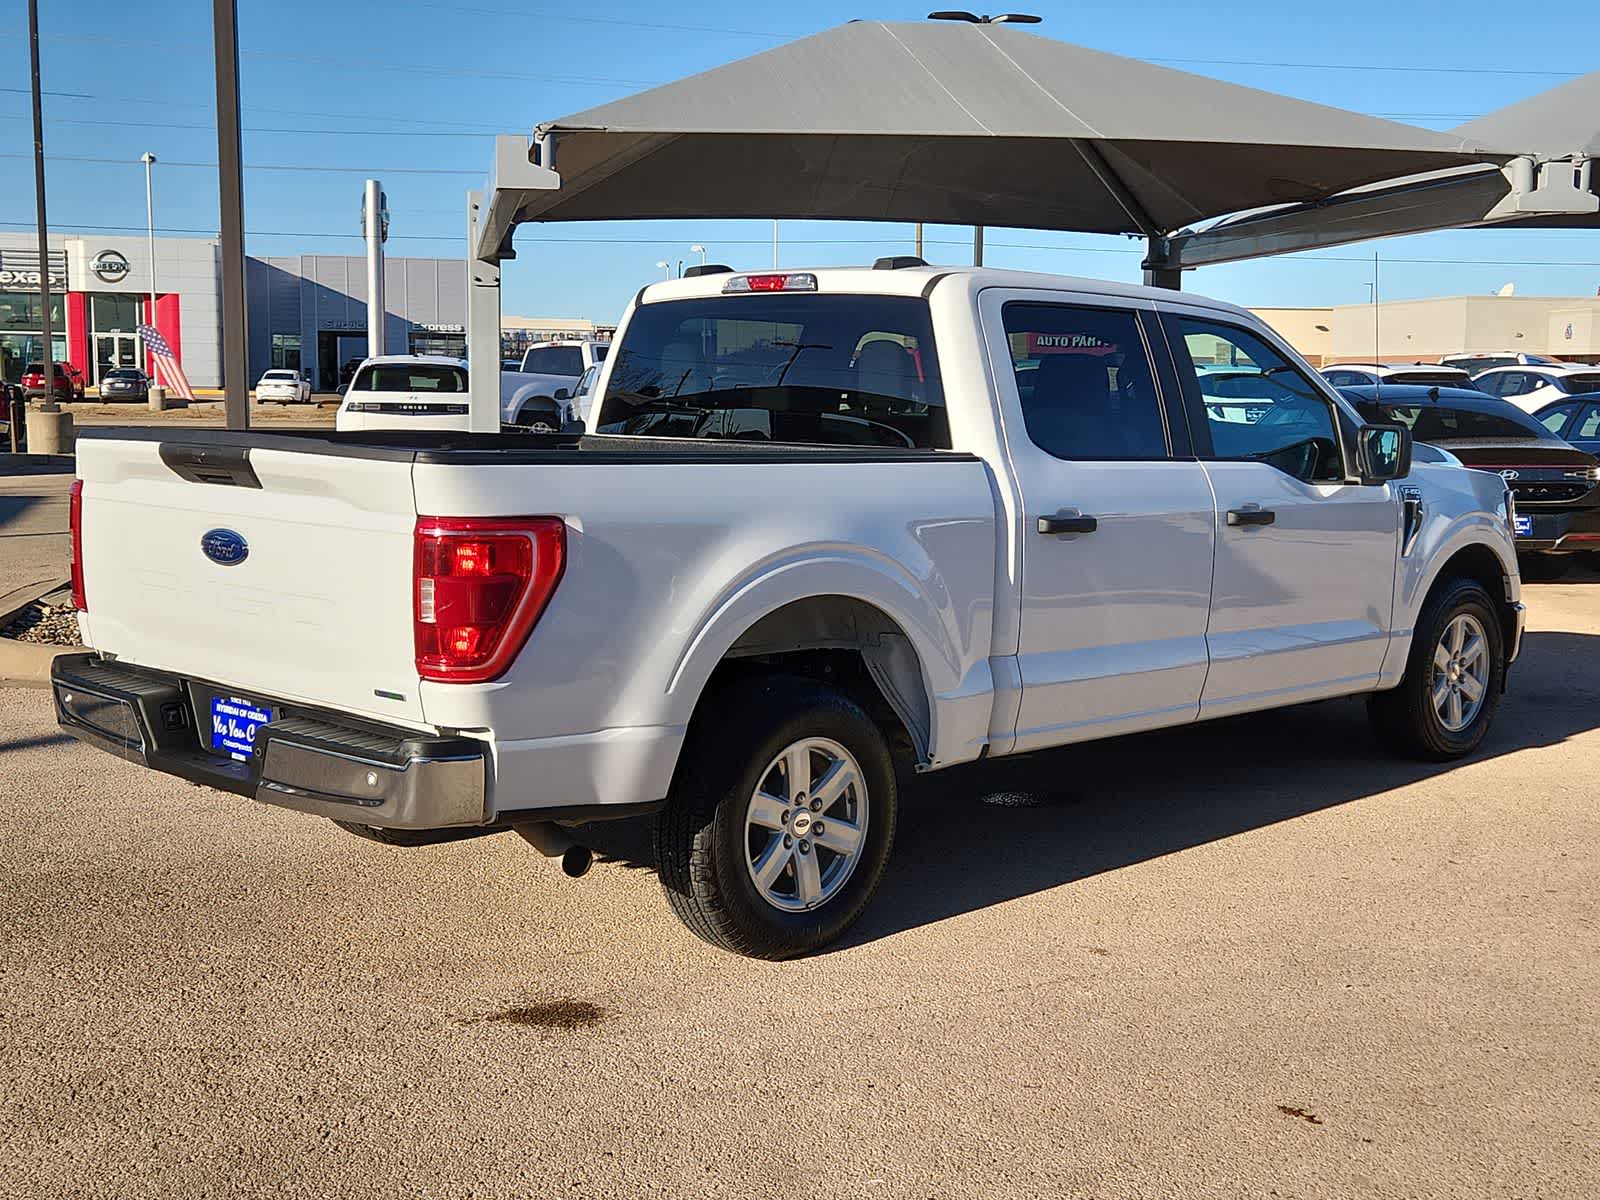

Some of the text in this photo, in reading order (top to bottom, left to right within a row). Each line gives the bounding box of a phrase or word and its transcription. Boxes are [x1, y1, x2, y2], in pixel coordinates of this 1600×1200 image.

[0, 270, 57, 284] exas
[412, 321, 463, 332] Express
[1037, 335, 1109, 348] AUTO PAR
[216, 703, 239, 716] HYUNDAI
[213, 715, 228, 735] Yes
[228, 719, 246, 739] You
